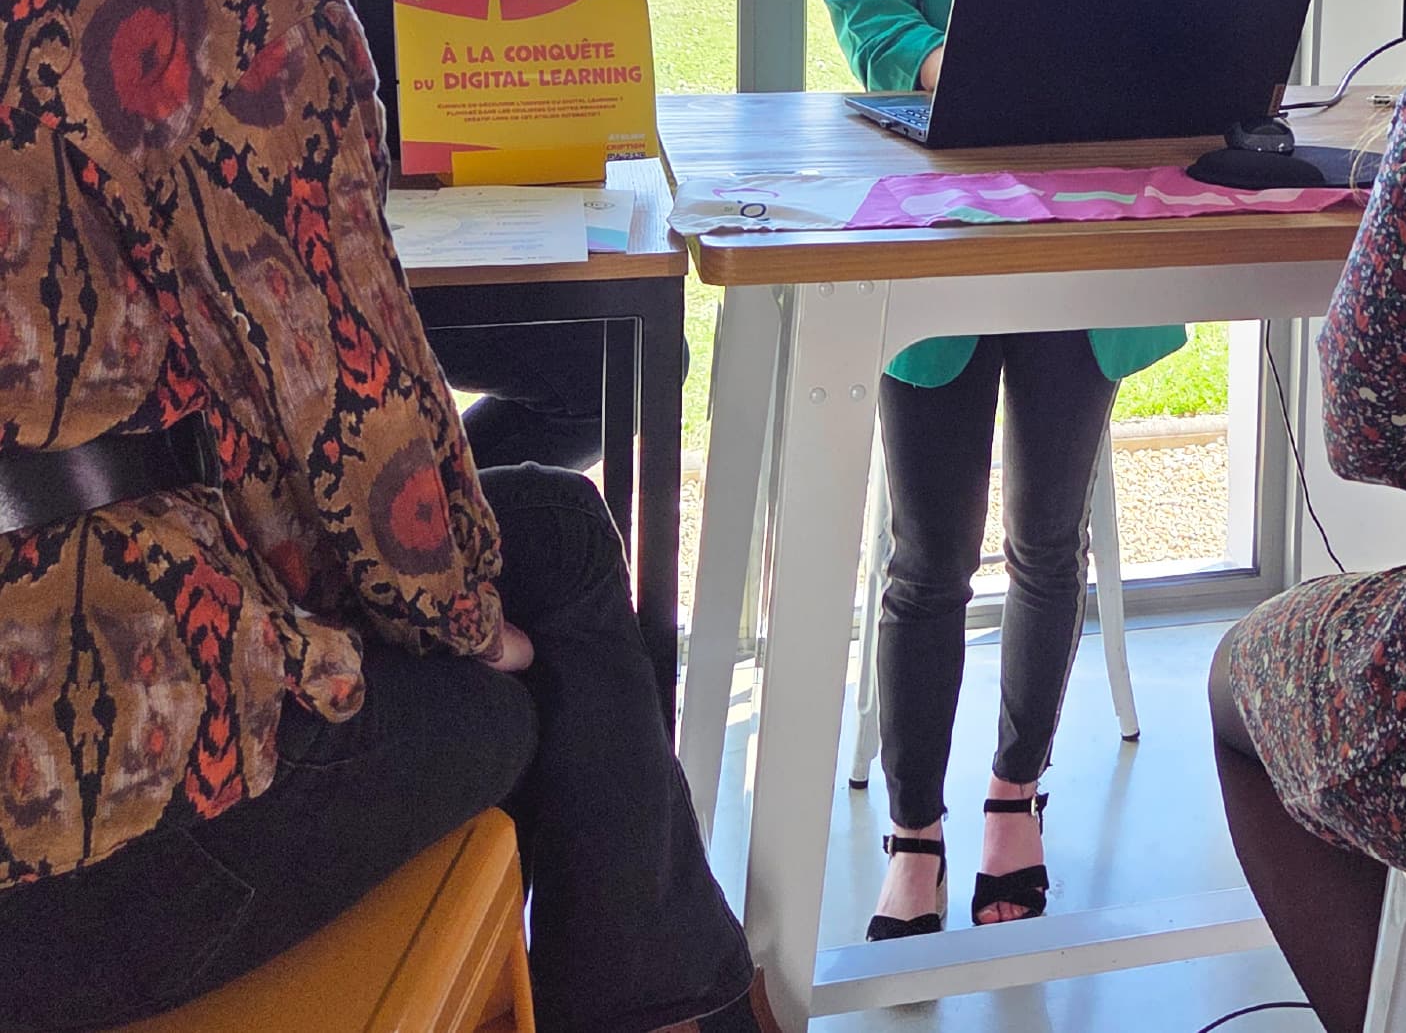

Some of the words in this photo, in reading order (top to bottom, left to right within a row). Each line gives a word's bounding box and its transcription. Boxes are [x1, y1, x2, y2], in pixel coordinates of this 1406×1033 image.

[441, 41, 457, 64] À
[466, 45, 495, 63] LA
[504, 38, 615, 62] CONQUÊTE
[413, 79, 434, 90] DU
[443, 70, 529, 89] DIGITAL
[538, 66, 642, 87] LEARNING
